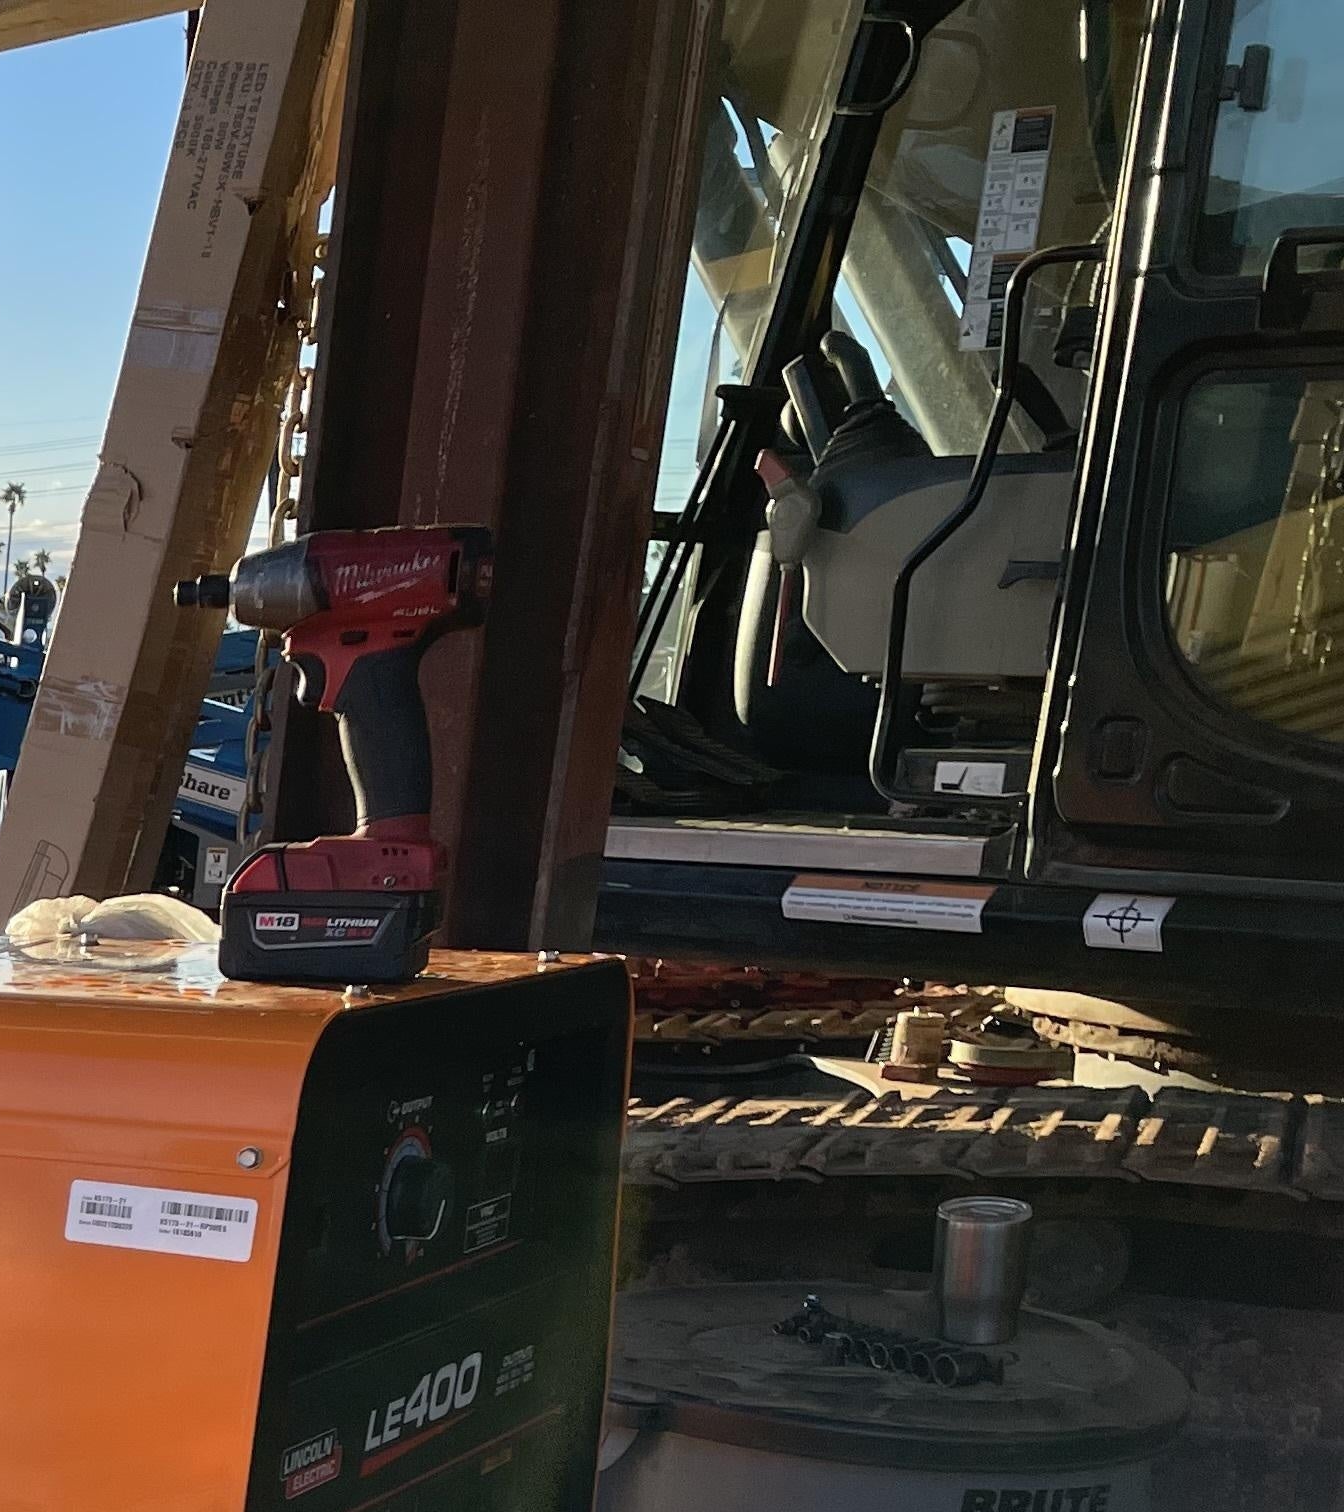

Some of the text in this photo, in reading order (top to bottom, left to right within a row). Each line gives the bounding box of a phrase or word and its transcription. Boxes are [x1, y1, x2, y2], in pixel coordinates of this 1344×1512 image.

[232, 117, 256, 179] FIXTURE
[259, 916, 296, 927] M18
[365, 1352, 482, 1452] LE400
[284, 1435, 334, 1475] LINCOLN
